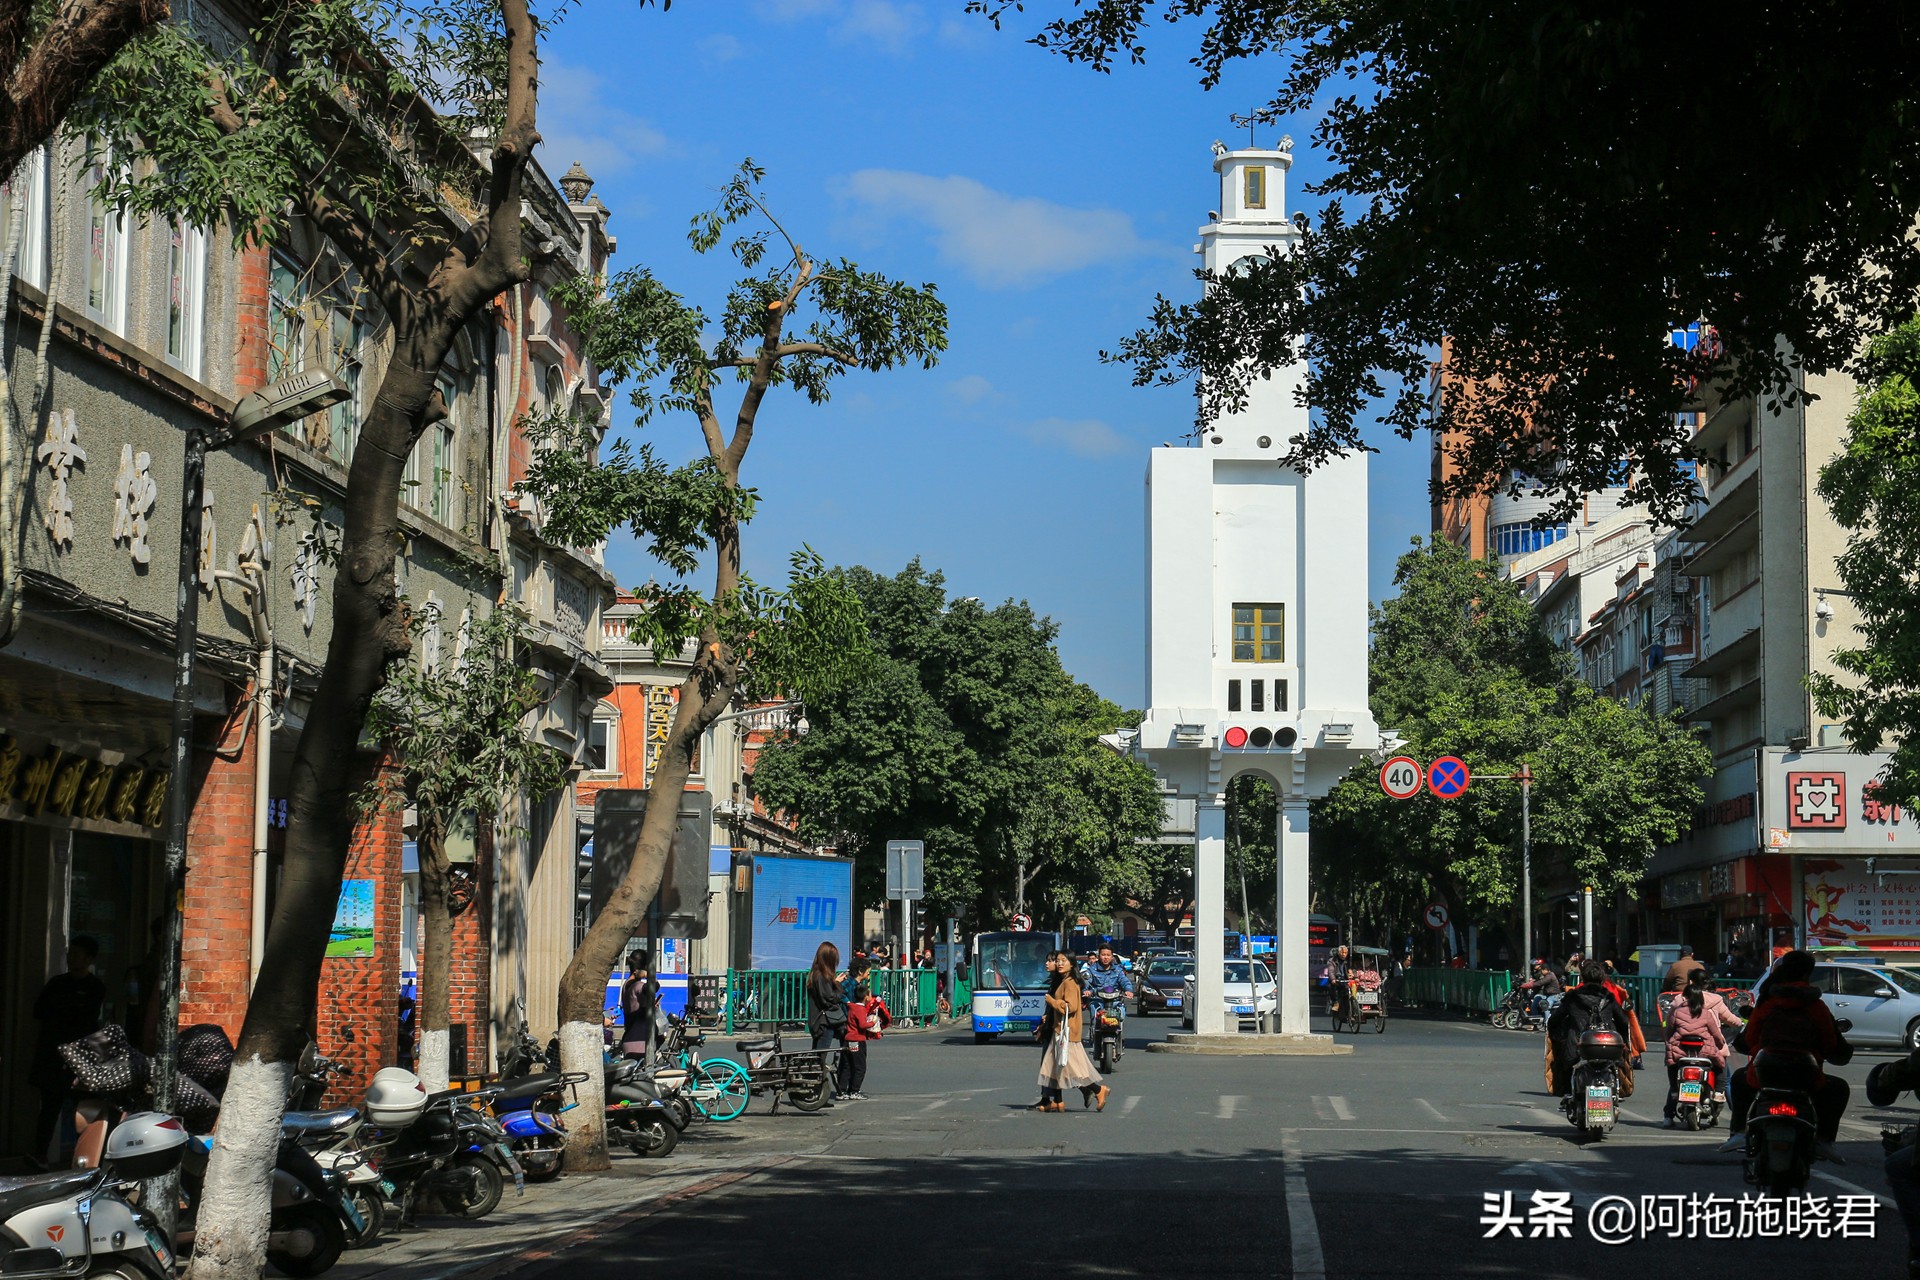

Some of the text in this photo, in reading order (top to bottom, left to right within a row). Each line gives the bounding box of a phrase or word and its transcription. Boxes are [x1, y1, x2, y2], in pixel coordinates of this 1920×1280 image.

[1389, 768, 1414, 788] 40
[794, 896, 838, 931] 100
[994, 999, 1040, 1009] 泉州 公交
